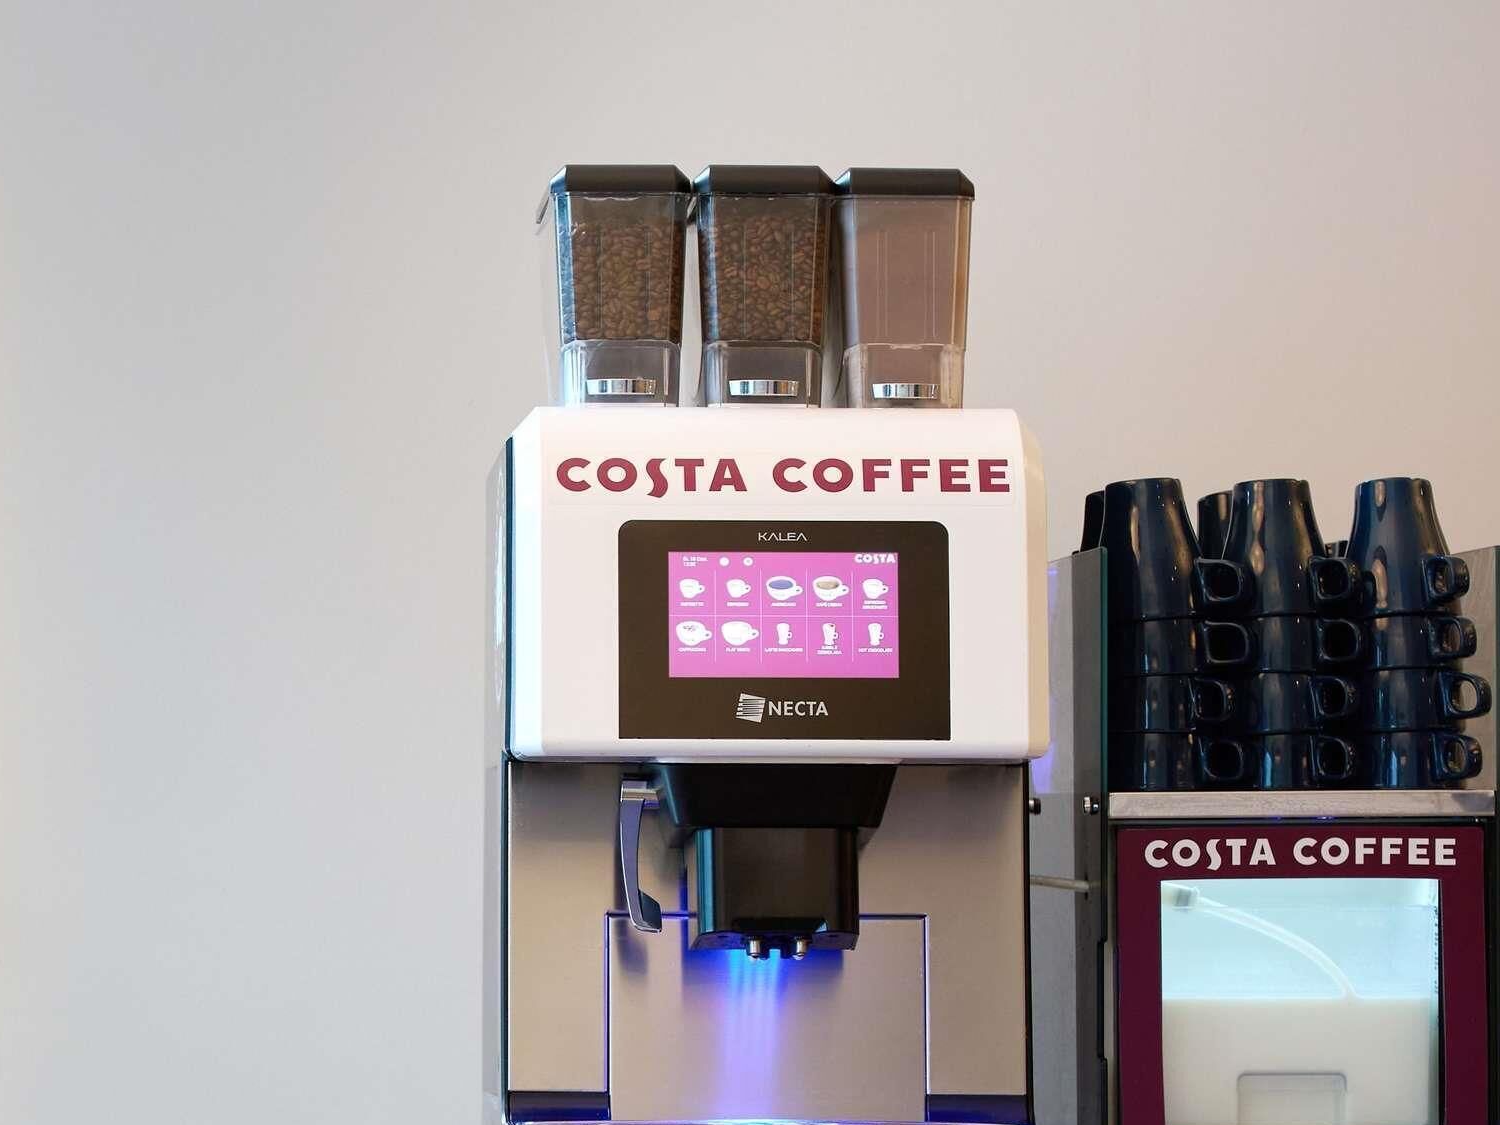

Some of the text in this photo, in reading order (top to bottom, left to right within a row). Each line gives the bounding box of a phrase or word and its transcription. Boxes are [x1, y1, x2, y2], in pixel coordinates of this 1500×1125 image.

[556, 457, 1011, 498] COSTA COFFEE
[757, 531, 808, 542] KALEA
[854, 552, 897, 565] COSTA
[767, 700, 829, 717] NECTA
[1144, 837, 1457, 871] COSTA COFFEE
